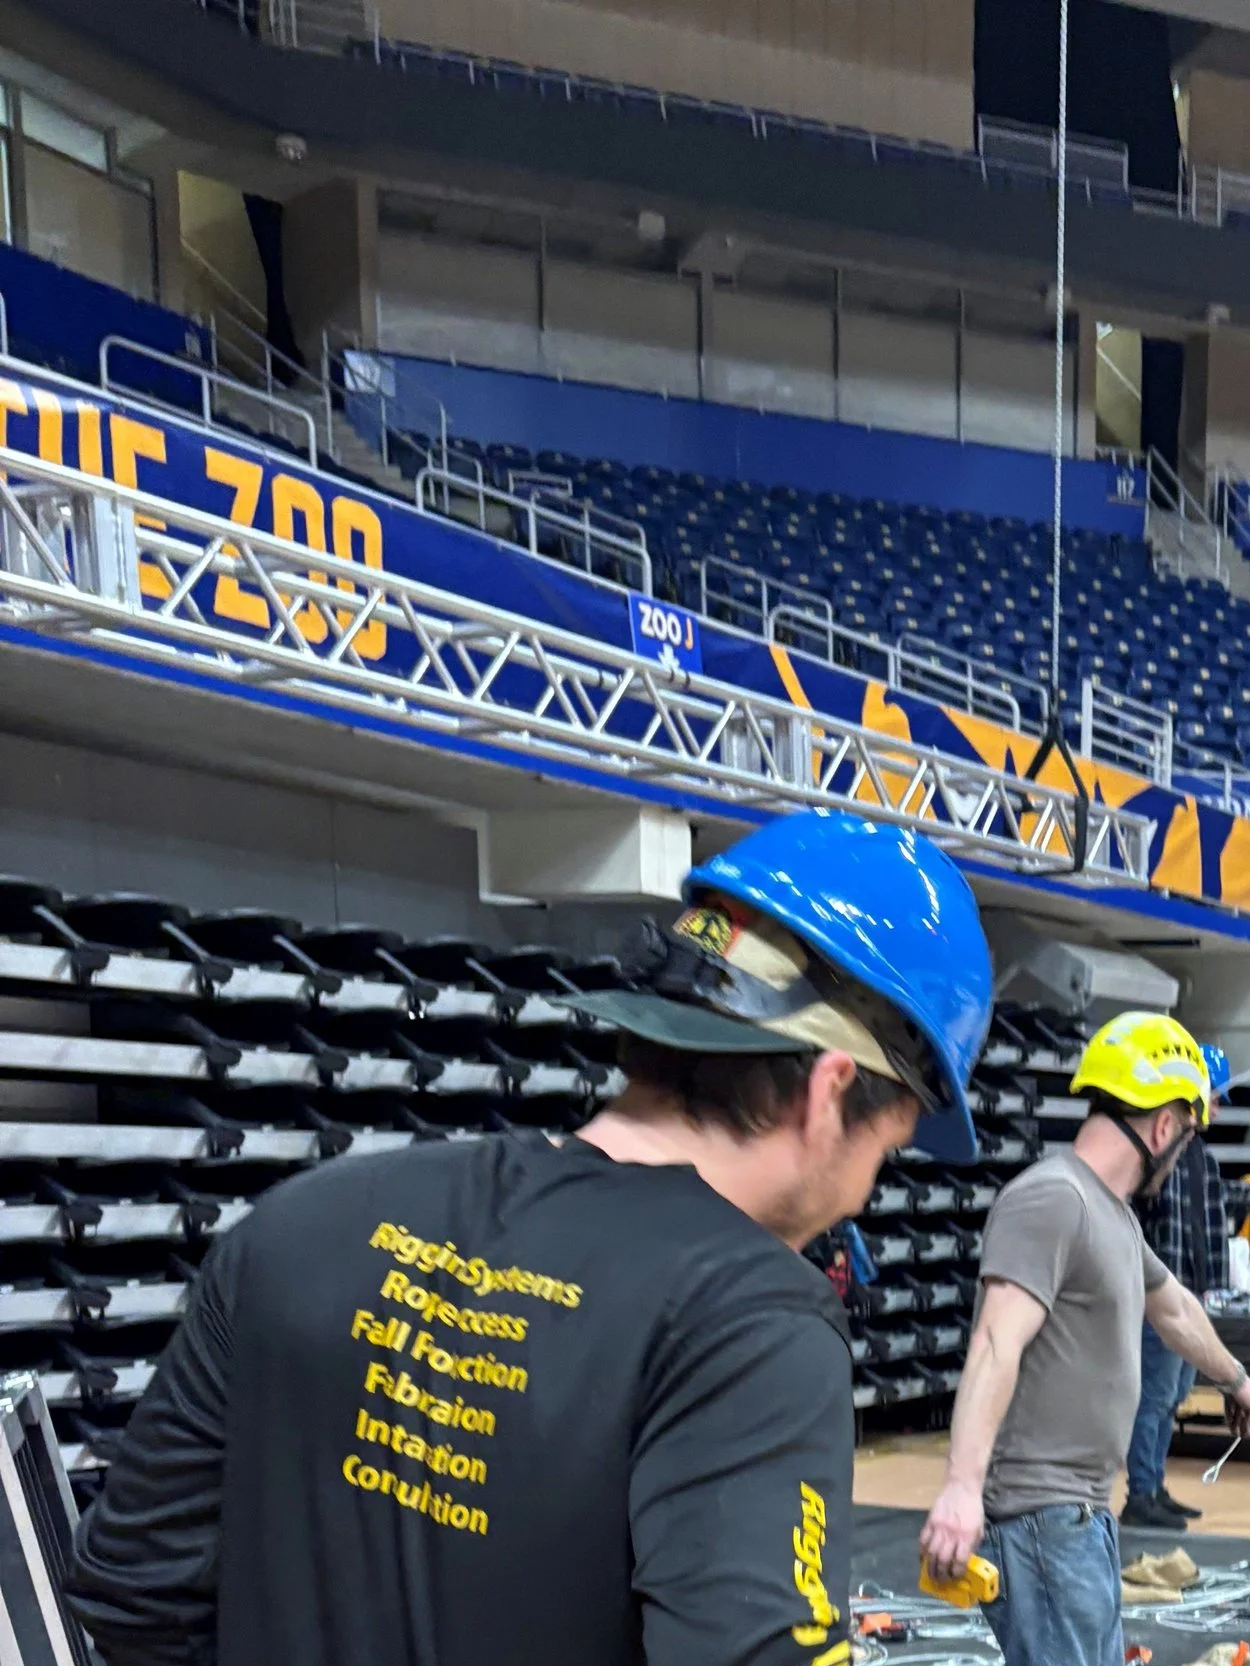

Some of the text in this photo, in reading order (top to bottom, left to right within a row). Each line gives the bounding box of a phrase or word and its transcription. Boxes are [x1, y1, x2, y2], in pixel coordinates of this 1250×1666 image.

[205, 446, 387, 661] ZOO
[638, 601, 694, 651] ZOO J
[351, 1308, 412, 1352] Fall
